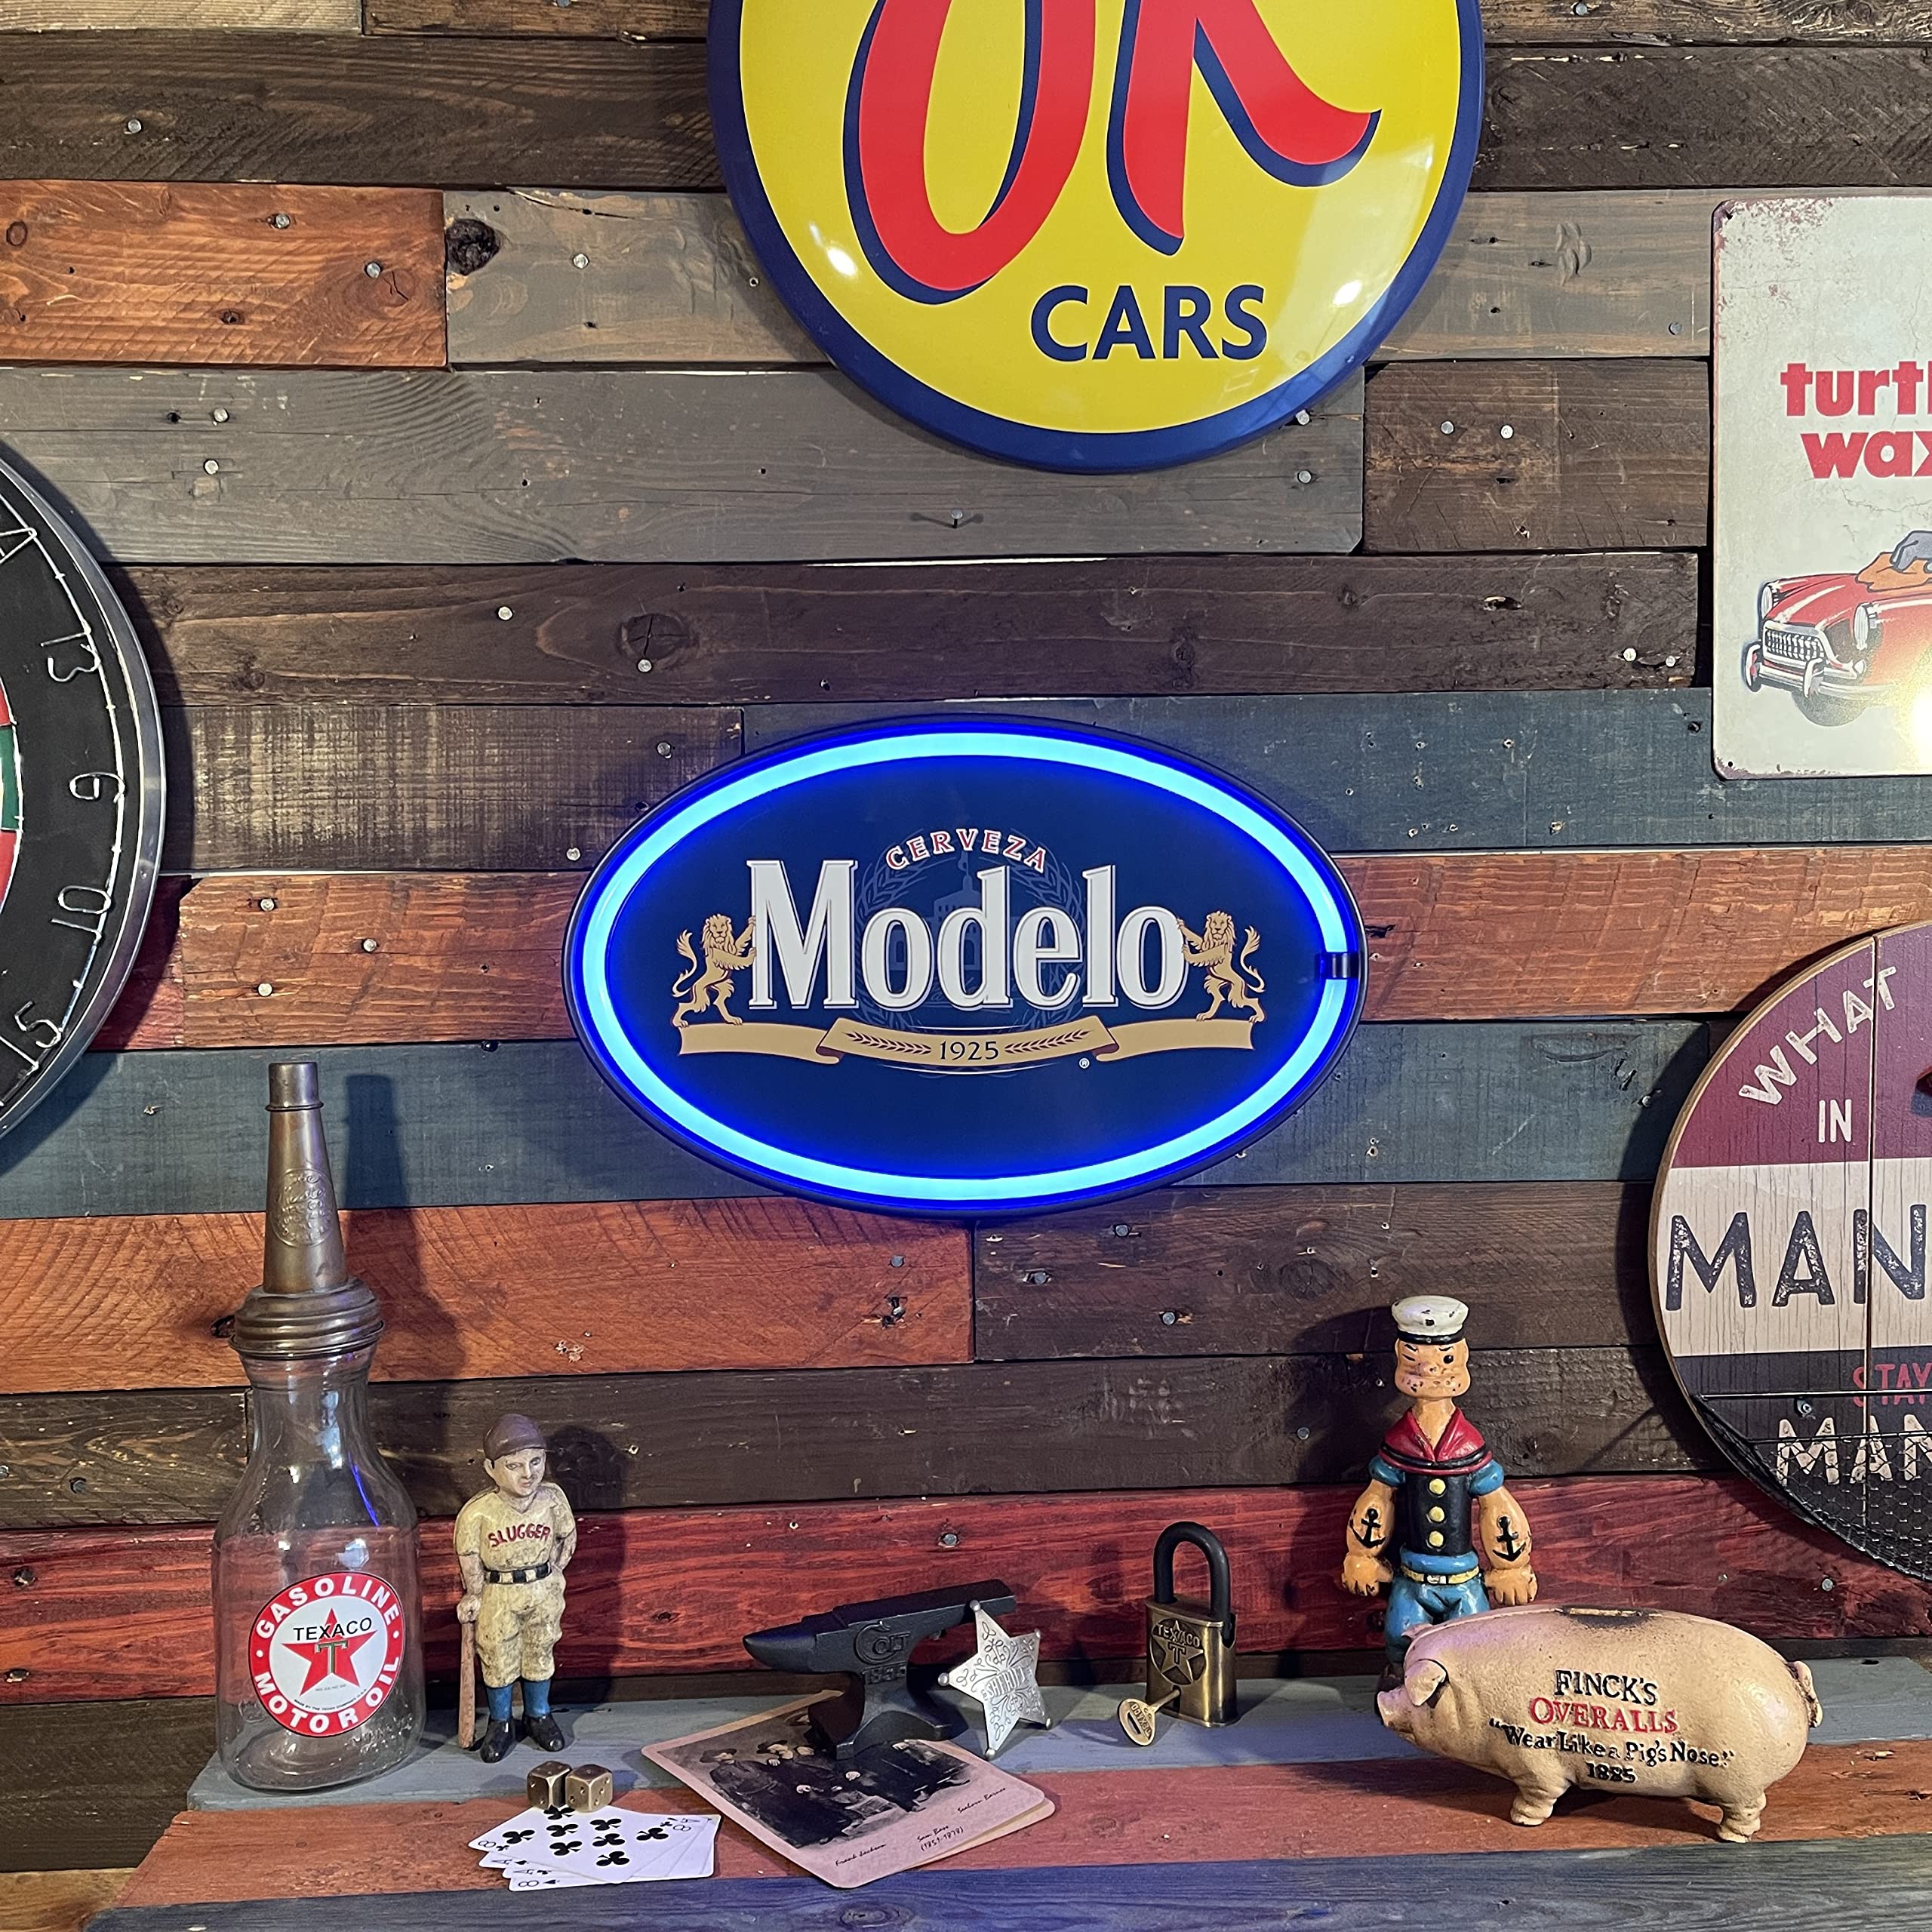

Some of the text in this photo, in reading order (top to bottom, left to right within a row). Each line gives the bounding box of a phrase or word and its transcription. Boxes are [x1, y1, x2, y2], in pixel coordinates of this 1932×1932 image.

[1029, 284, 1268, 361] CARS
[1780, 361, 1932, 417] turt
[40, 620, 102, 682] 13
[886, 828, 1047, 873] CERVEZA
[50, 884, 112, 942] 10
[746, 859, 1189, 1011] Modelo
[939, 1041, 1000, 1060] 1925
[1738, 966, 1897, 1106] WHAT
[1818, 1099, 1852, 1143] IN
[1665, 1204, 1927, 1312] MAN
[488, 1523, 551, 1548] SLUGGER
[256, 1575, 399, 1639] GASOLINE
[293, 1617, 373, 1642] TEXACO
[1155, 1623, 1201, 1648] TEXACO
[254, 1672, 359, 1734] MOTOR
[365, 1657, 399, 1707] OIL
[1553, 1669, 1658, 1706] FINCK'S
[1529, 1697, 1679, 1734] OVERALLS
[1586, 1761, 1637, 1784] 1885
